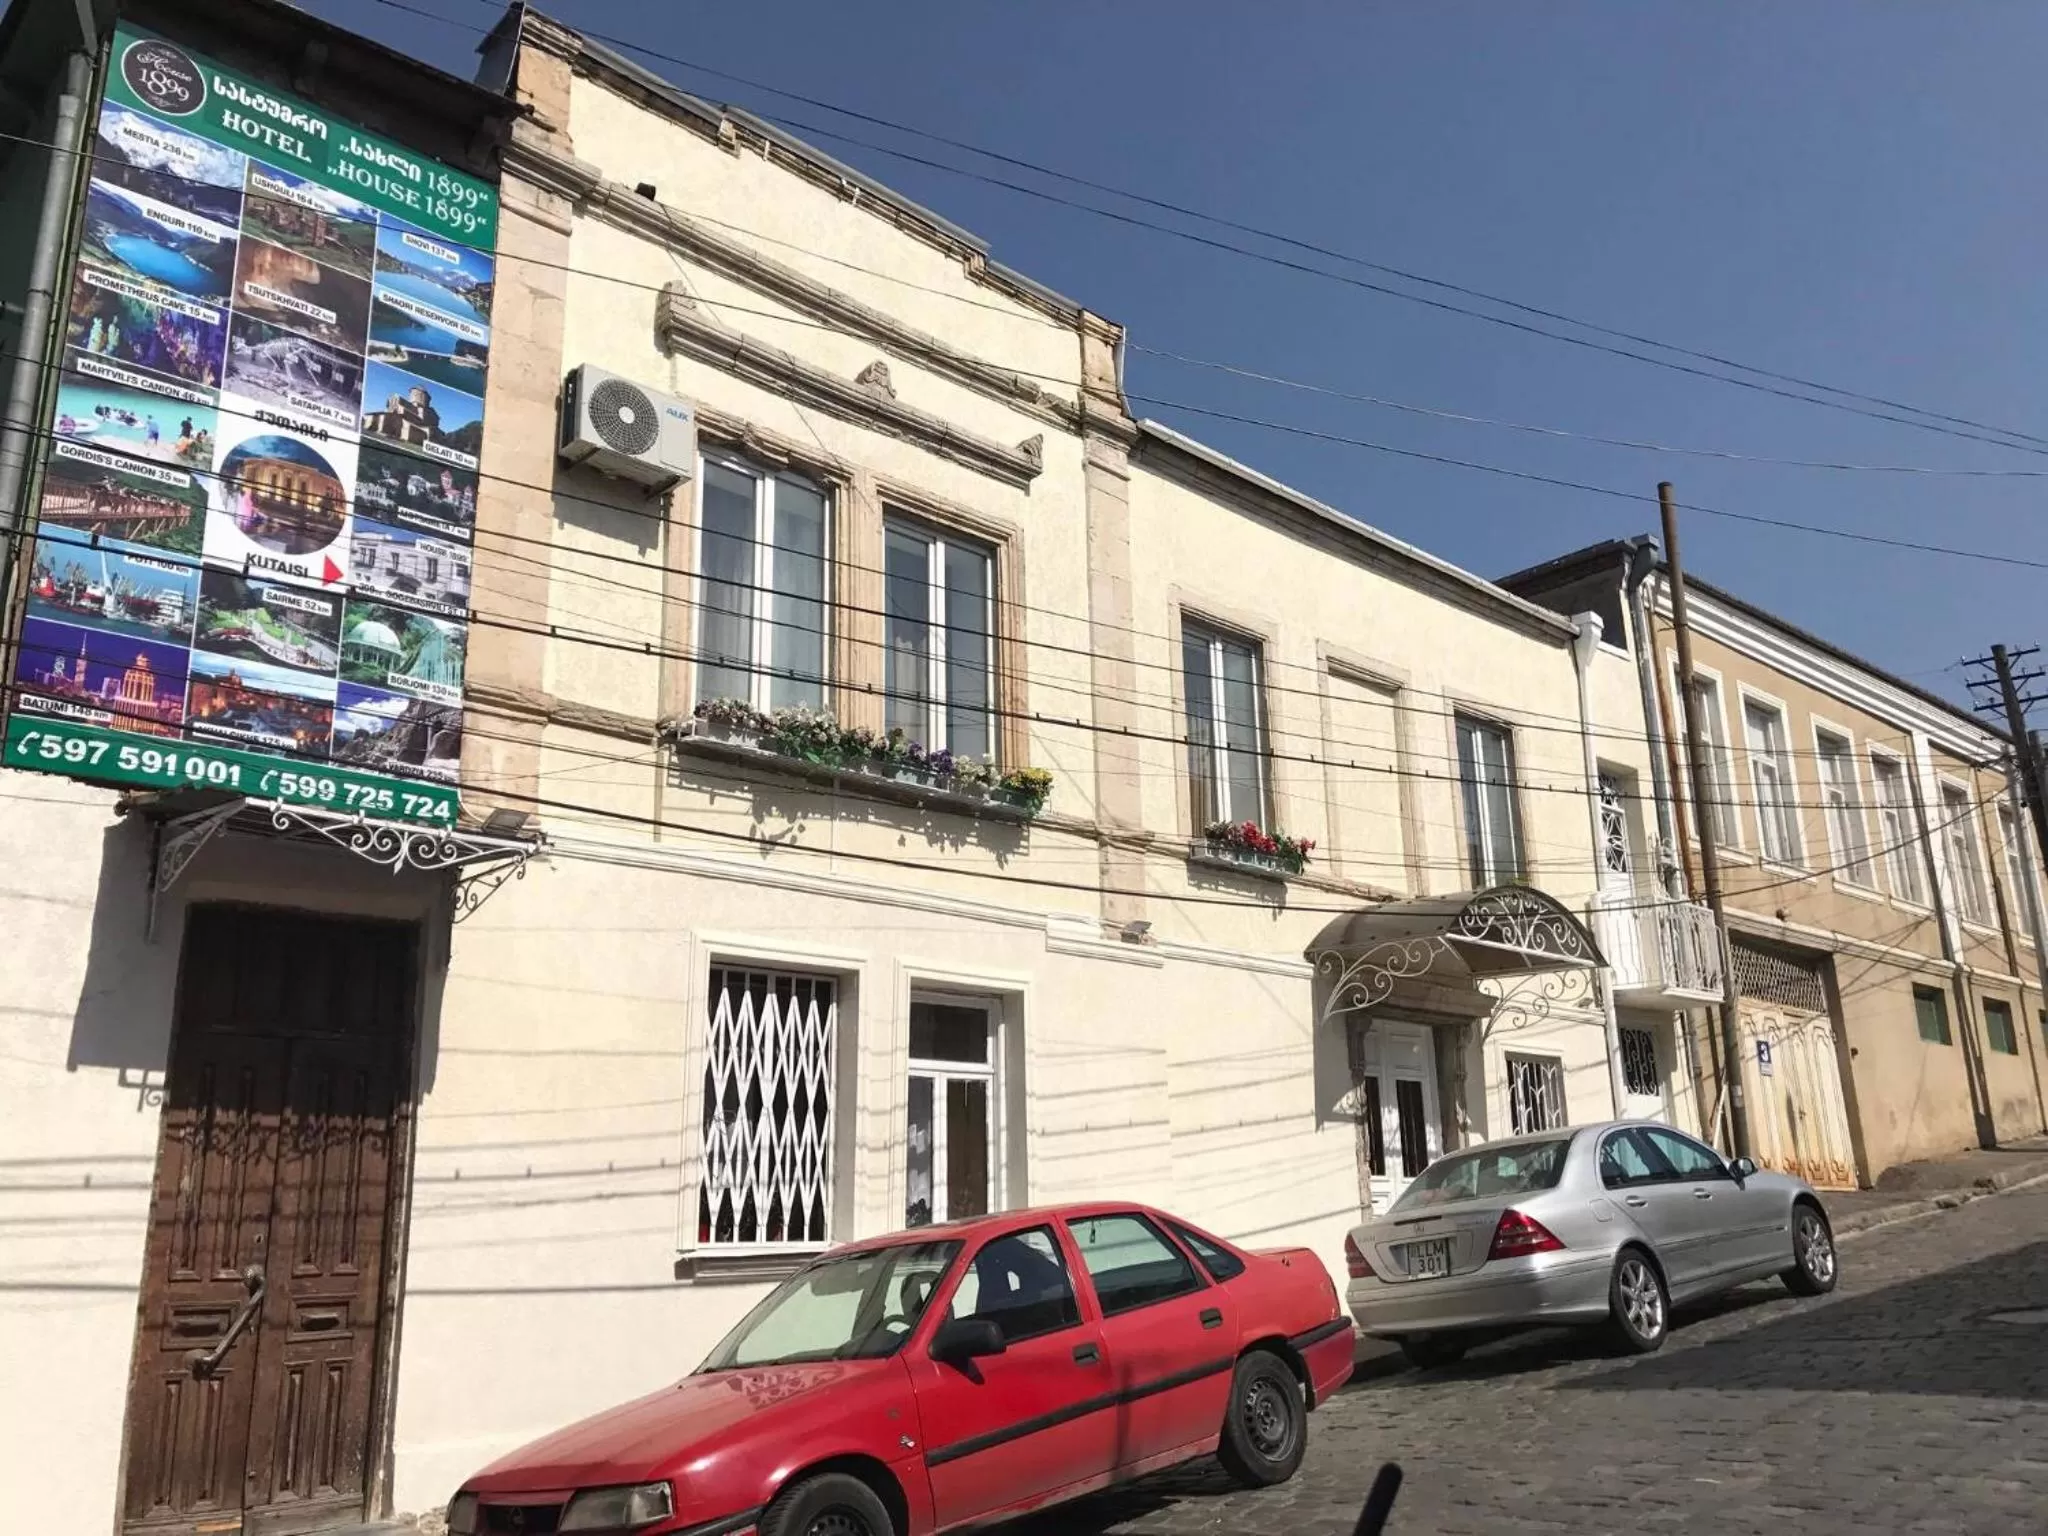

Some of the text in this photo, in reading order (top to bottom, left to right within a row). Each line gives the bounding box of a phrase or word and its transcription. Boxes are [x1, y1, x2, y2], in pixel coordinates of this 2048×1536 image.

[138, 69, 190, 101] 1899
[213, 75, 328, 140] სასტუმრო
[122, 127, 160, 147] MESTIA
[182, 150, 196, 161] km
[222, 109, 312, 163] HOTEL
[146, 207, 185, 228] ENGURI
[204, 228, 217, 241] km
[88, 273, 216, 322] PROMETHEUS CAVE 15 km
[248, 285, 309, 311] TSUTSKHVATI
[309, 304, 321, 317] 22
[382, 293, 414, 310] SHAORI
[140, 379, 181, 397] CANION
[290, 397, 332, 417] SATAPLIA
[334, 409, 340, 418] 7
[425, 443, 453, 459] GELATI
[114, 459, 156, 477] CANION
[156, 470, 172, 481] 35
[247, 552, 310, 578] KUTAISI
[266, 591, 330, 613] SAIRME 52 km
[390, 675, 430, 691] BORJOMI
[23, 697, 68, 712] BATUMI
[39, 734, 241, 786] 597 591 001
[279, 772, 451, 820] 599 725 724
[1416, 1240, 1444, 1257] LLM
[1419, 1256, 1441, 1273] 301
